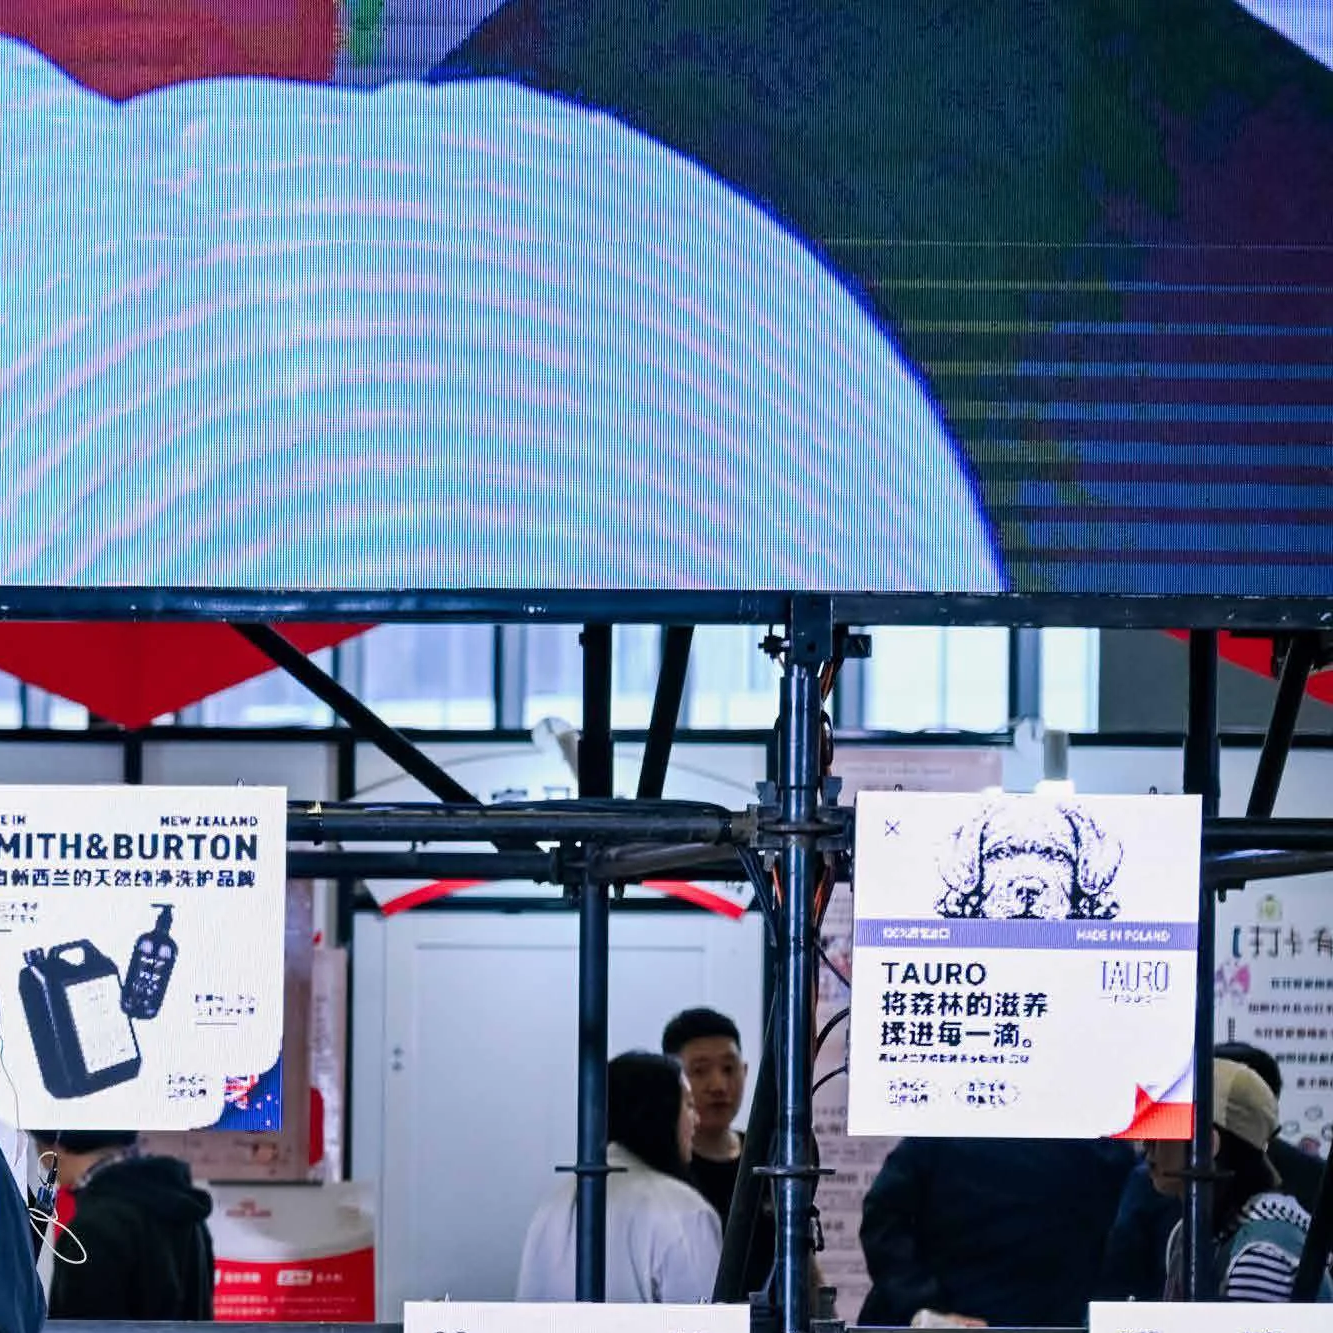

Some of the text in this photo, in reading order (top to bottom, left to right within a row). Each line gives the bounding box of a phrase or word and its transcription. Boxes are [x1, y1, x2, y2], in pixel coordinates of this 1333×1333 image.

[12, 814, 27, 826] IN
[160, 815, 191, 827] NEW
[196, 815, 258, 827] ZEALAND
[882, 962, 987, 985] TAURO
[882, 992, 1048, 1018] 将森林的滋养
